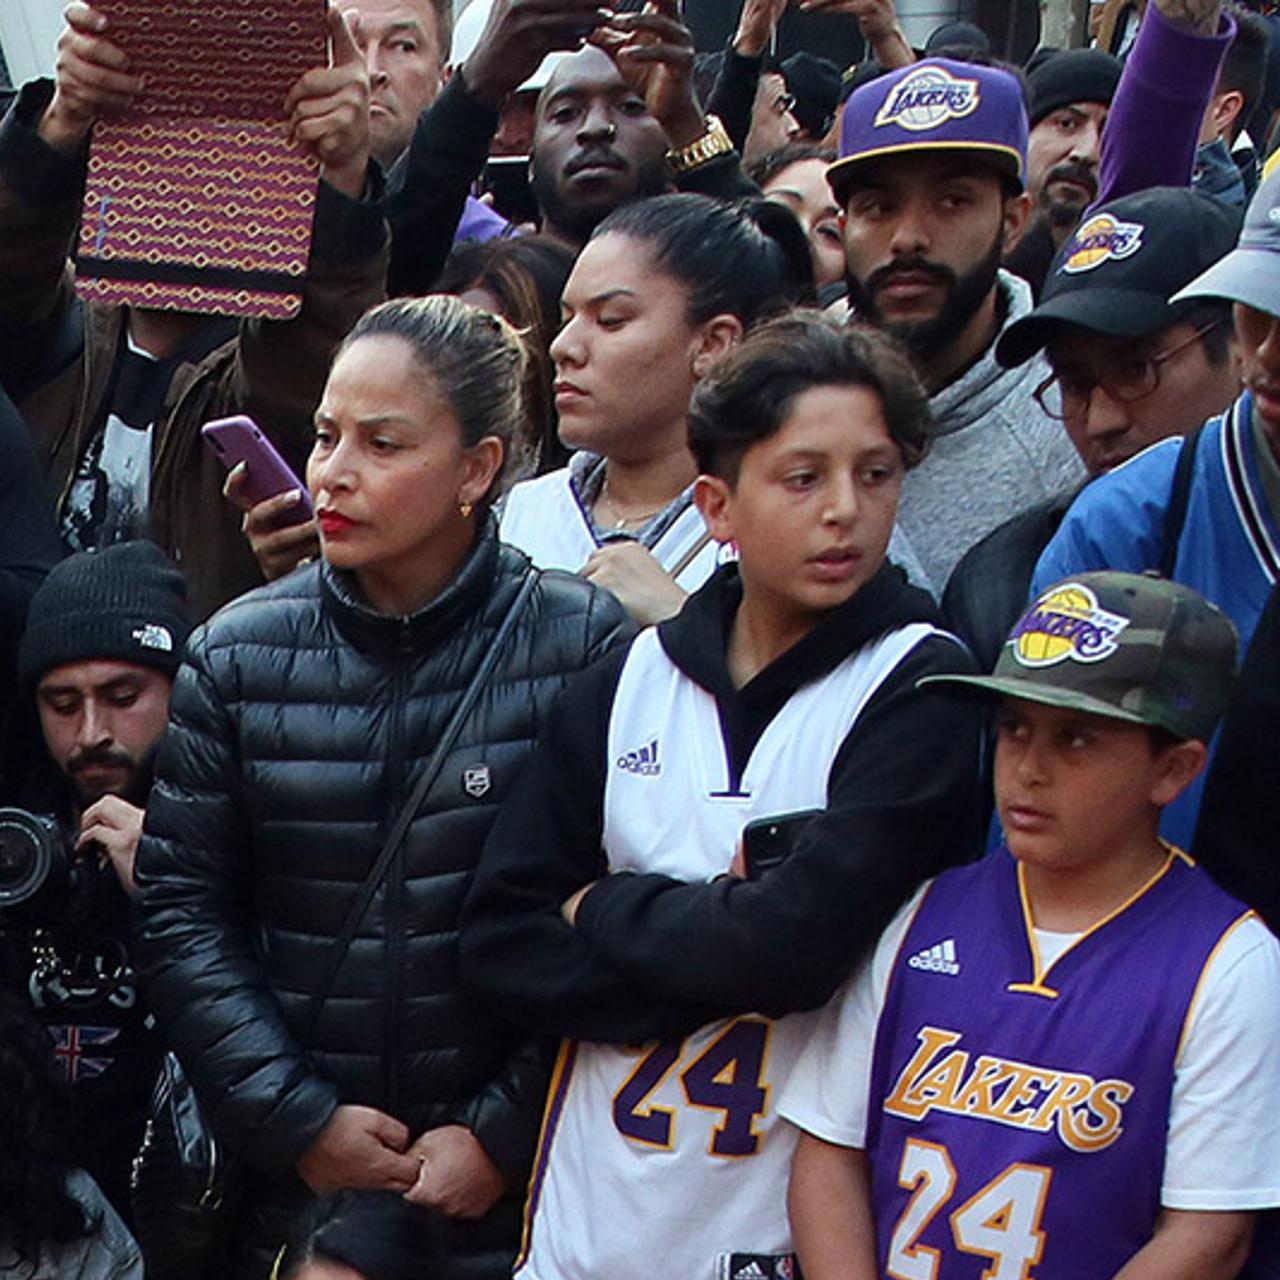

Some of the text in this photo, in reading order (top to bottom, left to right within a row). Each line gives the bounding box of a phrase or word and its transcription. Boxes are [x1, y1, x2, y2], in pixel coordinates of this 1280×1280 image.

[880, 84, 976, 122] LAKERS
[907, 954, 960, 976] adidas
[611, 1011, 775, 1157] 24
[883, 1026, 1134, 1153] LAKERS
